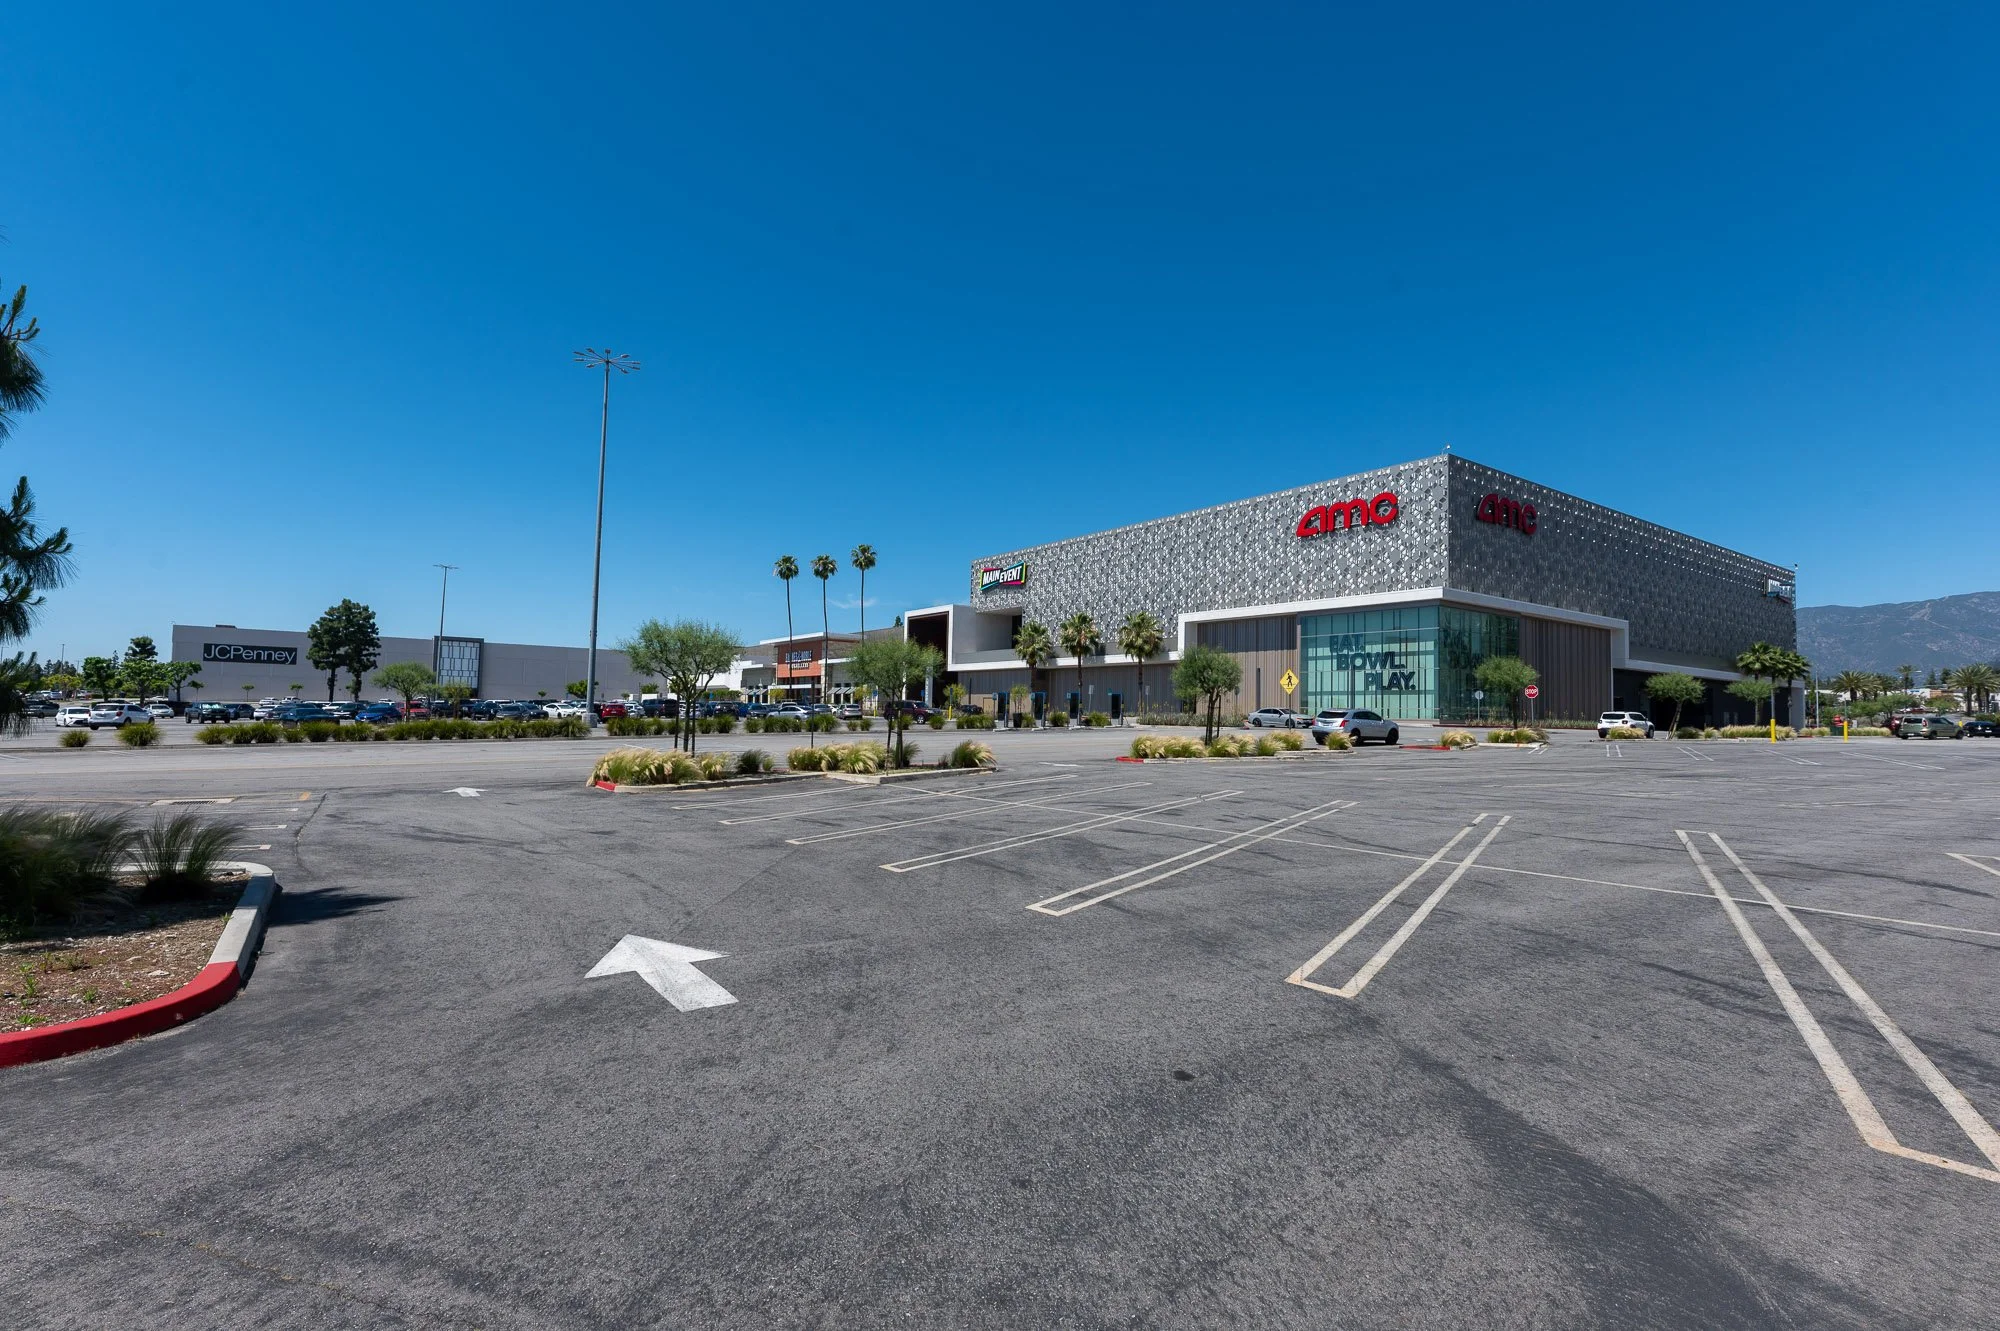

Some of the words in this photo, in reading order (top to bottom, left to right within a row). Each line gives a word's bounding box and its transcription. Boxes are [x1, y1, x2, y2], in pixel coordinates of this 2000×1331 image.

[983, 569, 1001, 585] MAIN
[999, 565, 1023, 583] EVENT
[204, 645, 296, 665] JCPenney
[1337, 651, 1406, 670] BOWL.
[1365, 672, 1417, 691] PLAY.
